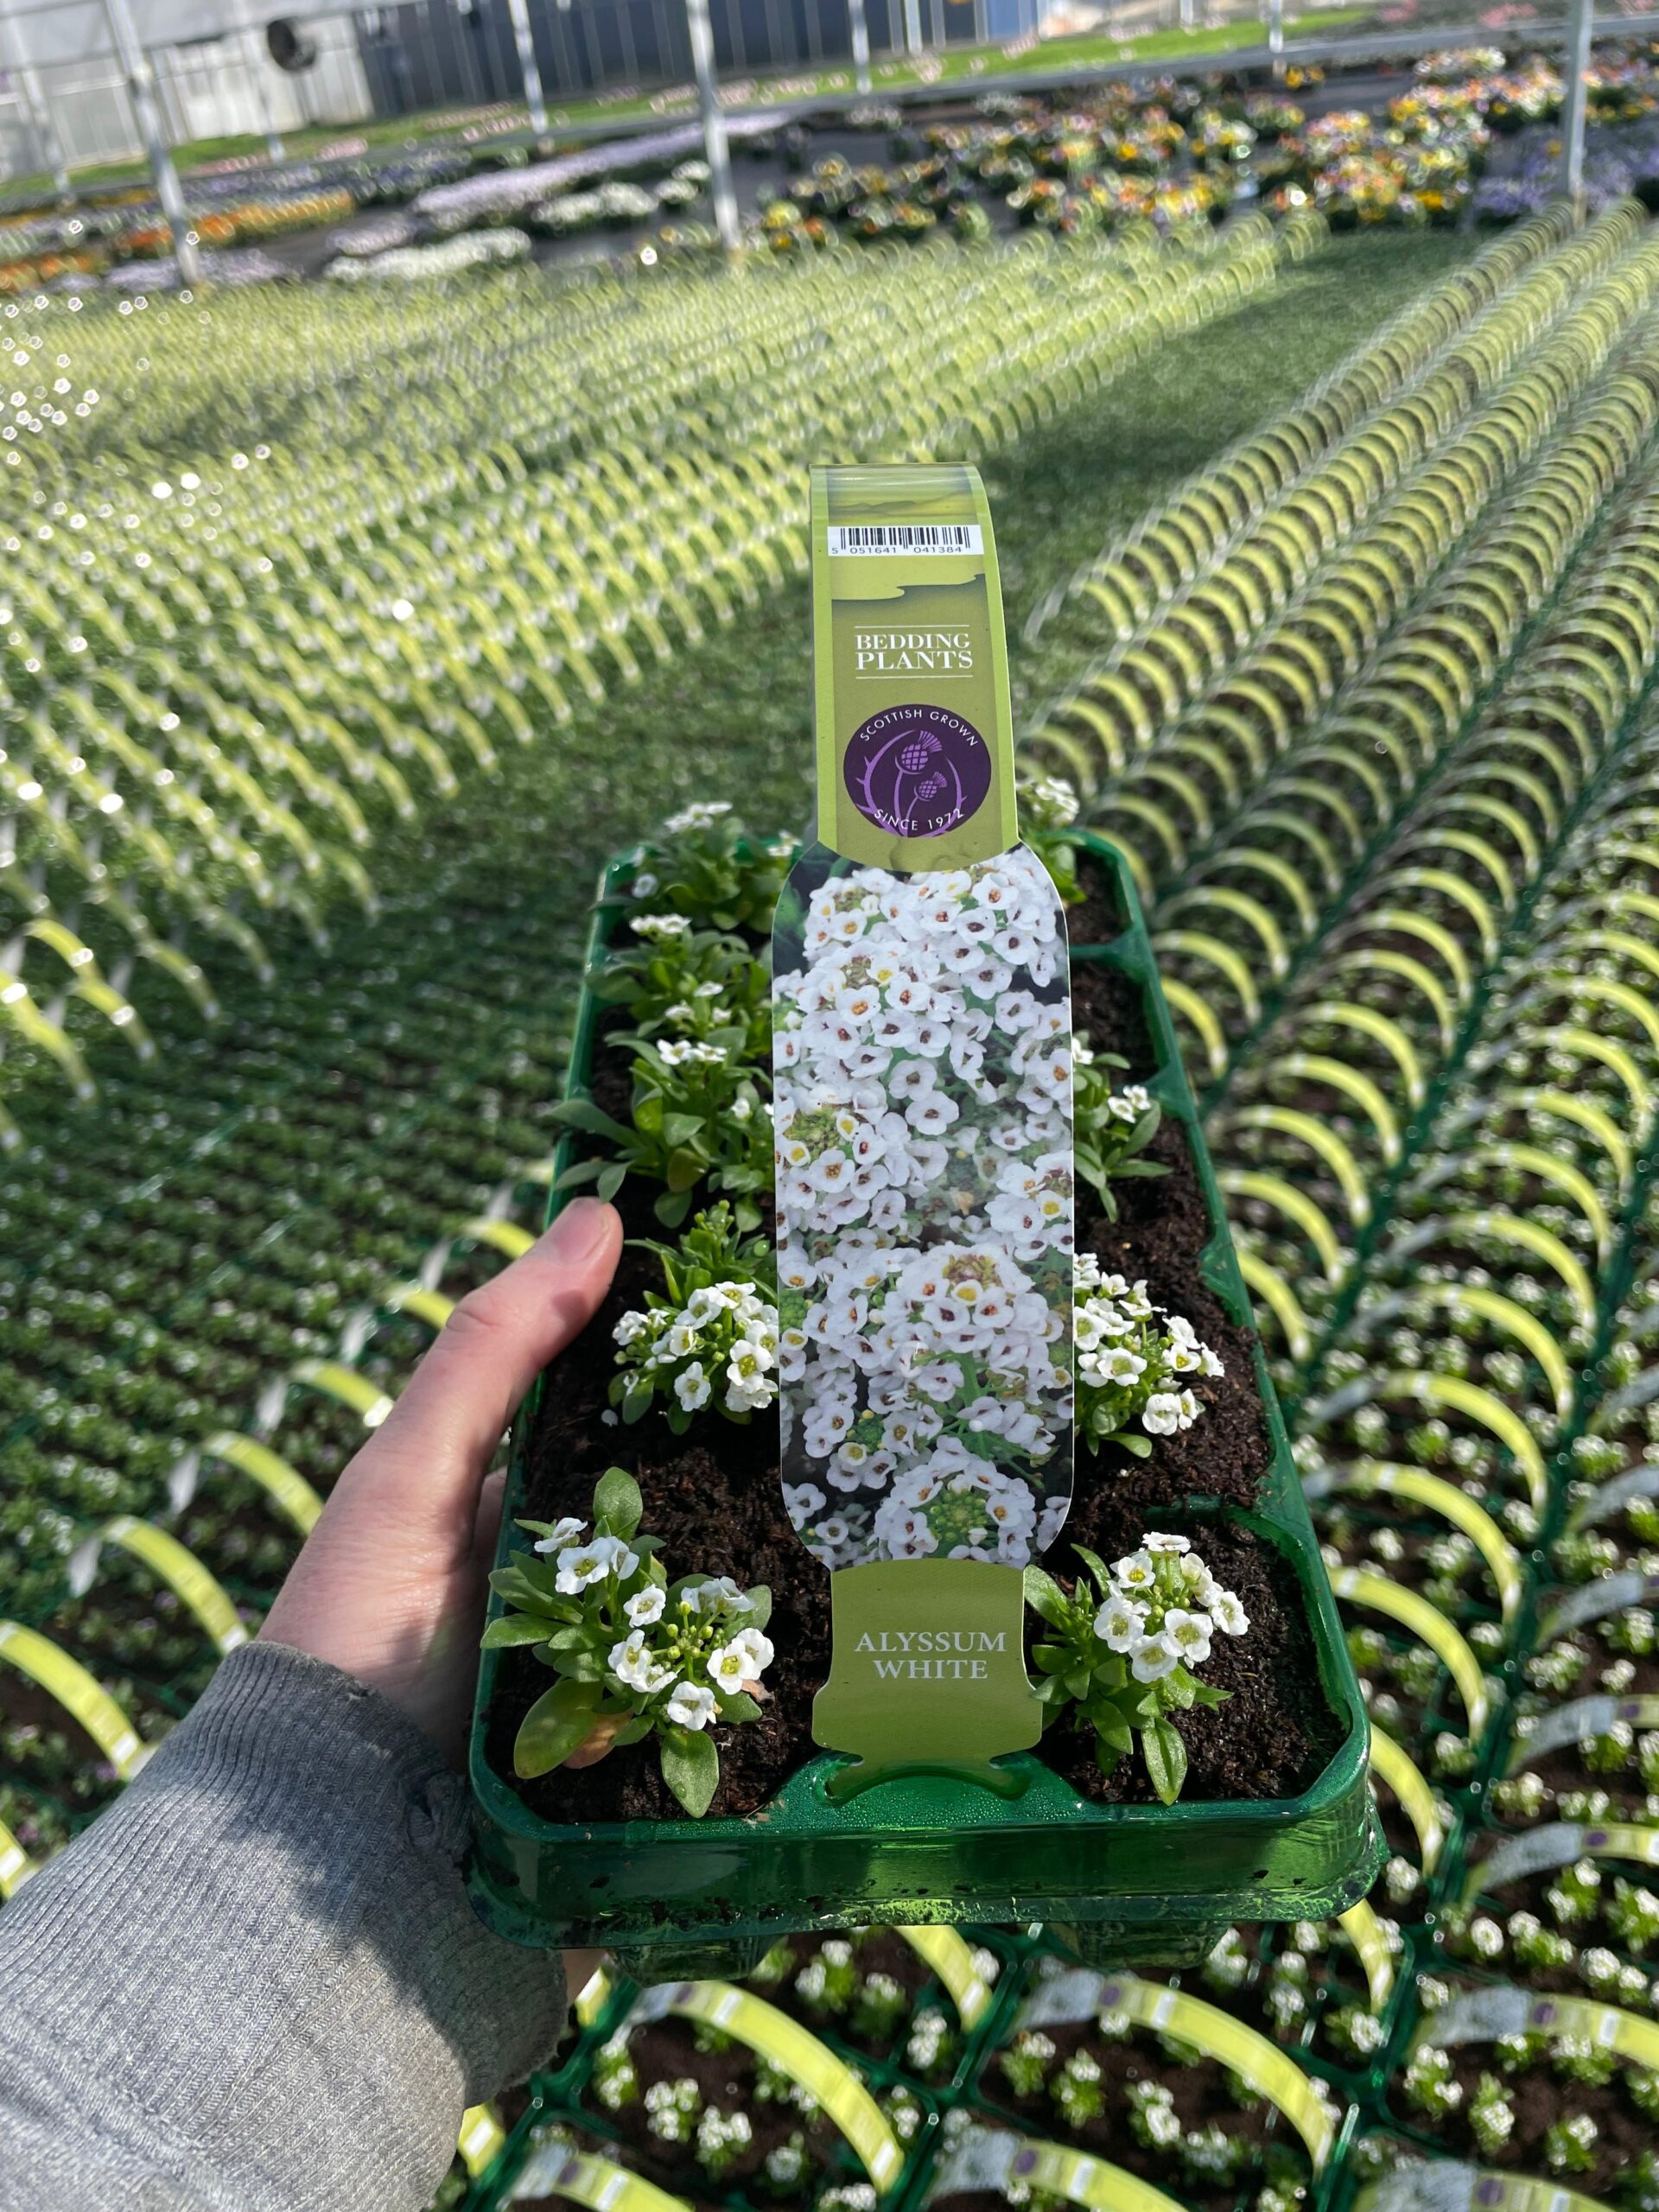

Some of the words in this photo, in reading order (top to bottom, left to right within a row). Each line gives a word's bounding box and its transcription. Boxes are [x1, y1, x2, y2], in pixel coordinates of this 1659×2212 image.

[855, 633, 970, 650] BEDDING
[855, 651, 973, 671] PLANTS
[860, 709, 922, 741] SCOTTISH
[930, 712, 978, 747] GROWN
[874, 810, 918, 830] SINCE
[928, 809, 964, 830] 1972
[855, 1631, 1007, 1652] ALYSSUM
[873, 1660, 988, 1679] WHITE
